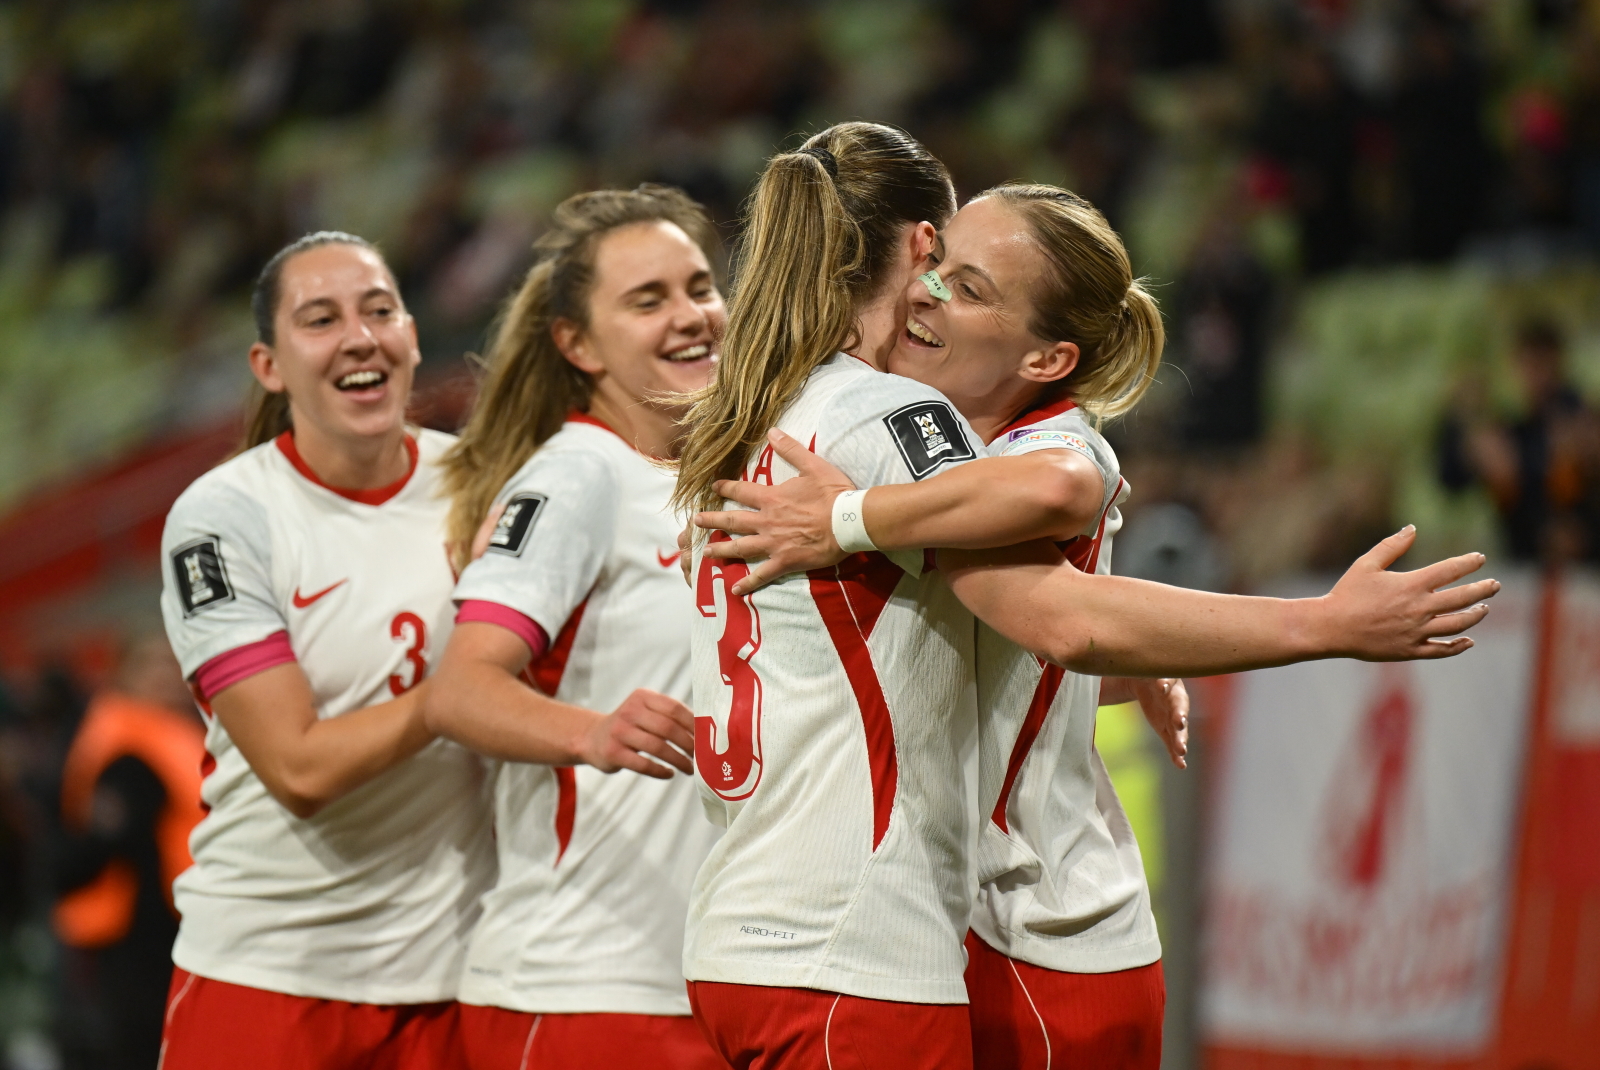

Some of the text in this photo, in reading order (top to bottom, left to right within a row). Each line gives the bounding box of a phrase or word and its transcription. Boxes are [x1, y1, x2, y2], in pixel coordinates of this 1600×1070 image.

[389, 611, 430, 698] 3
[694, 530, 763, 801] 3
[740, 925, 797, 940] AERO-FIT
